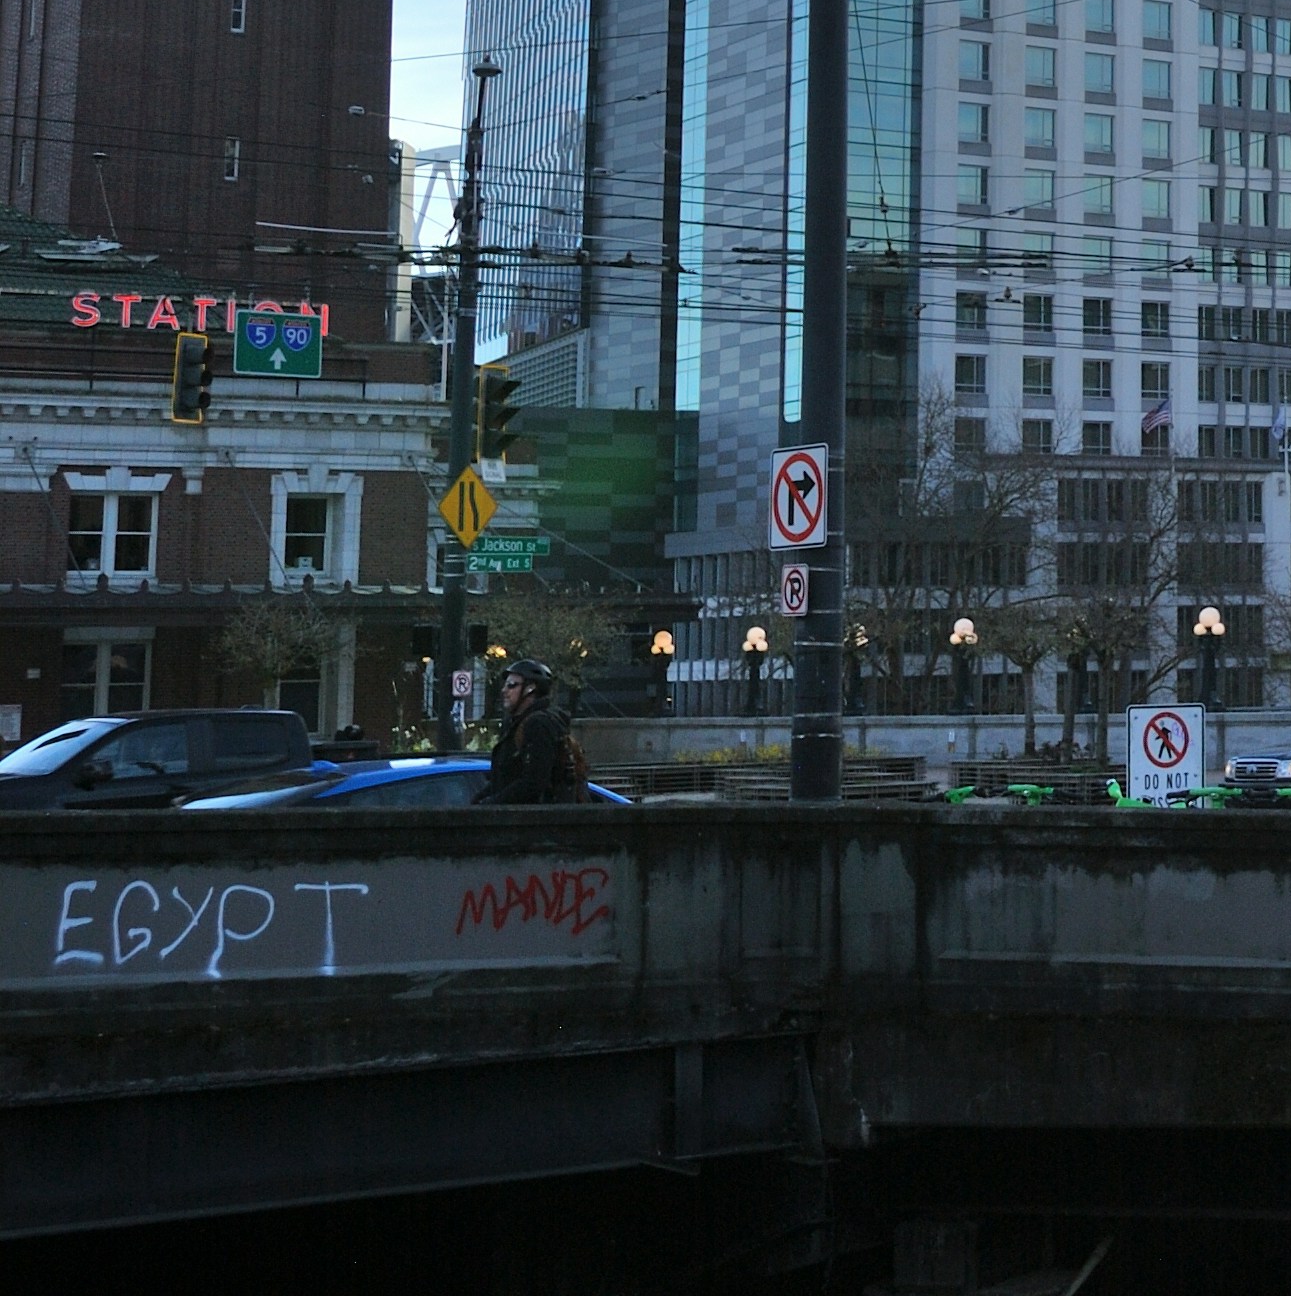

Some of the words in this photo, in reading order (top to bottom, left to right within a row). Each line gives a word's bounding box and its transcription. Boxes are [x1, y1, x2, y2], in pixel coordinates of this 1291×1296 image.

[255, 326, 267, 344] 5
[286, 328, 308, 345] 90
[481, 537, 523, 552] Jackson
[526, 542, 536, 552] St
[468, 556, 487, 571] 2nd
[507, 558, 519, 568] Ext
[524, 558, 530, 568] S
[1144, 773, 1159, 790] DO
[1166, 772, 1189, 789] NOT
[55, 880, 369, 978] EGYPT
